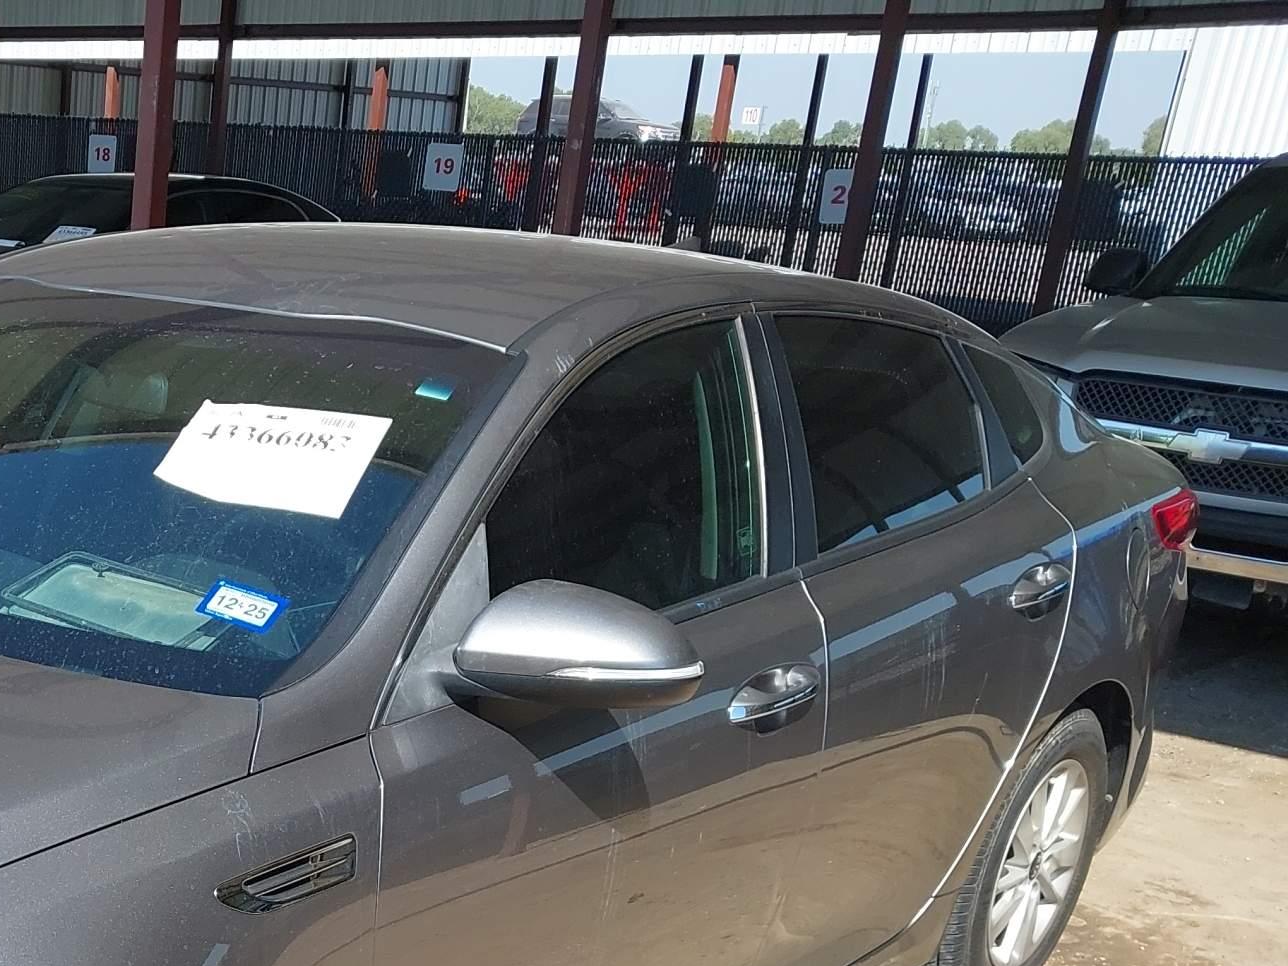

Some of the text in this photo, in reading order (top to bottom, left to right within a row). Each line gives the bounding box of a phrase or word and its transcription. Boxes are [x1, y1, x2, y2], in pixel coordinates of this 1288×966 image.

[95, 147, 110, 161] 18
[435, 157, 454, 174] 19
[831, 185, 847, 204] 2
[217, 595, 239, 610] 12
[243, 603, 269, 620] 25
